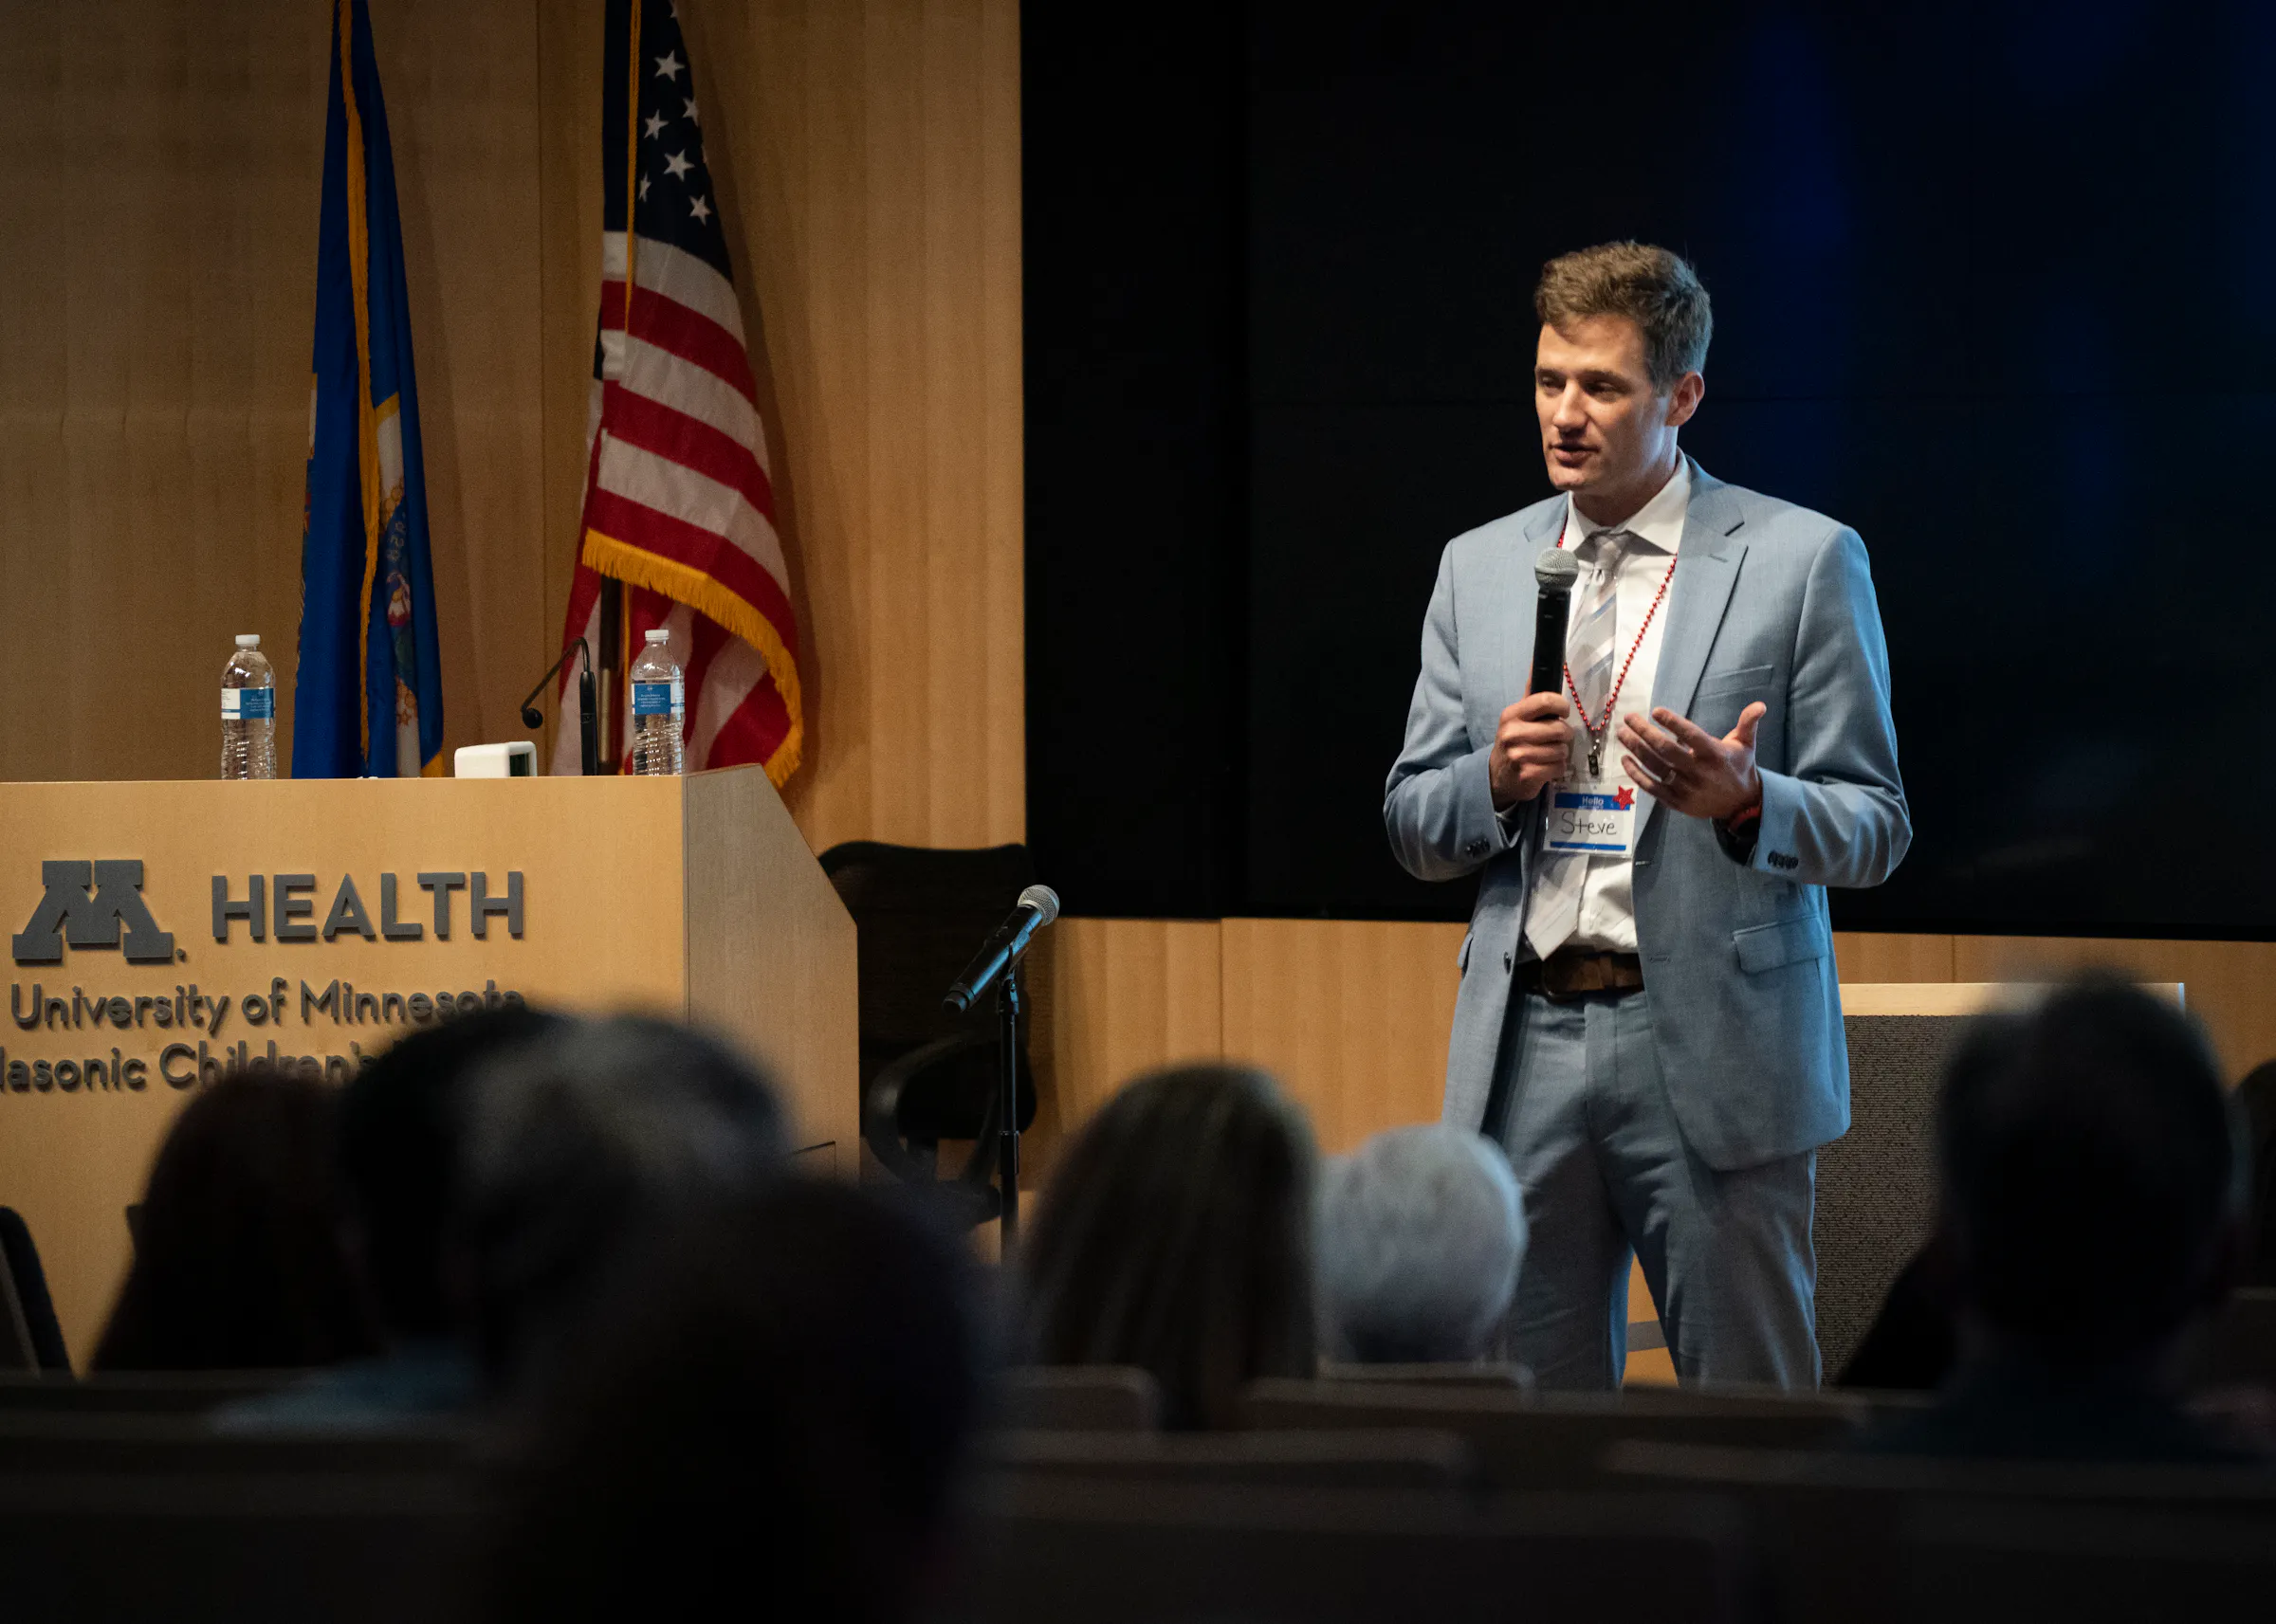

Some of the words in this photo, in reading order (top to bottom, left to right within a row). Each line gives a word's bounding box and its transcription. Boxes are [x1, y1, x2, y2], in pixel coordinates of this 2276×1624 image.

[1560, 811, 1616, 834] Steve
[211, 871, 523, 942] HEALTH
[11, 983, 230, 1035] University
[242, 976, 286, 1025] of
[0, 1046, 146, 1091] asonic
